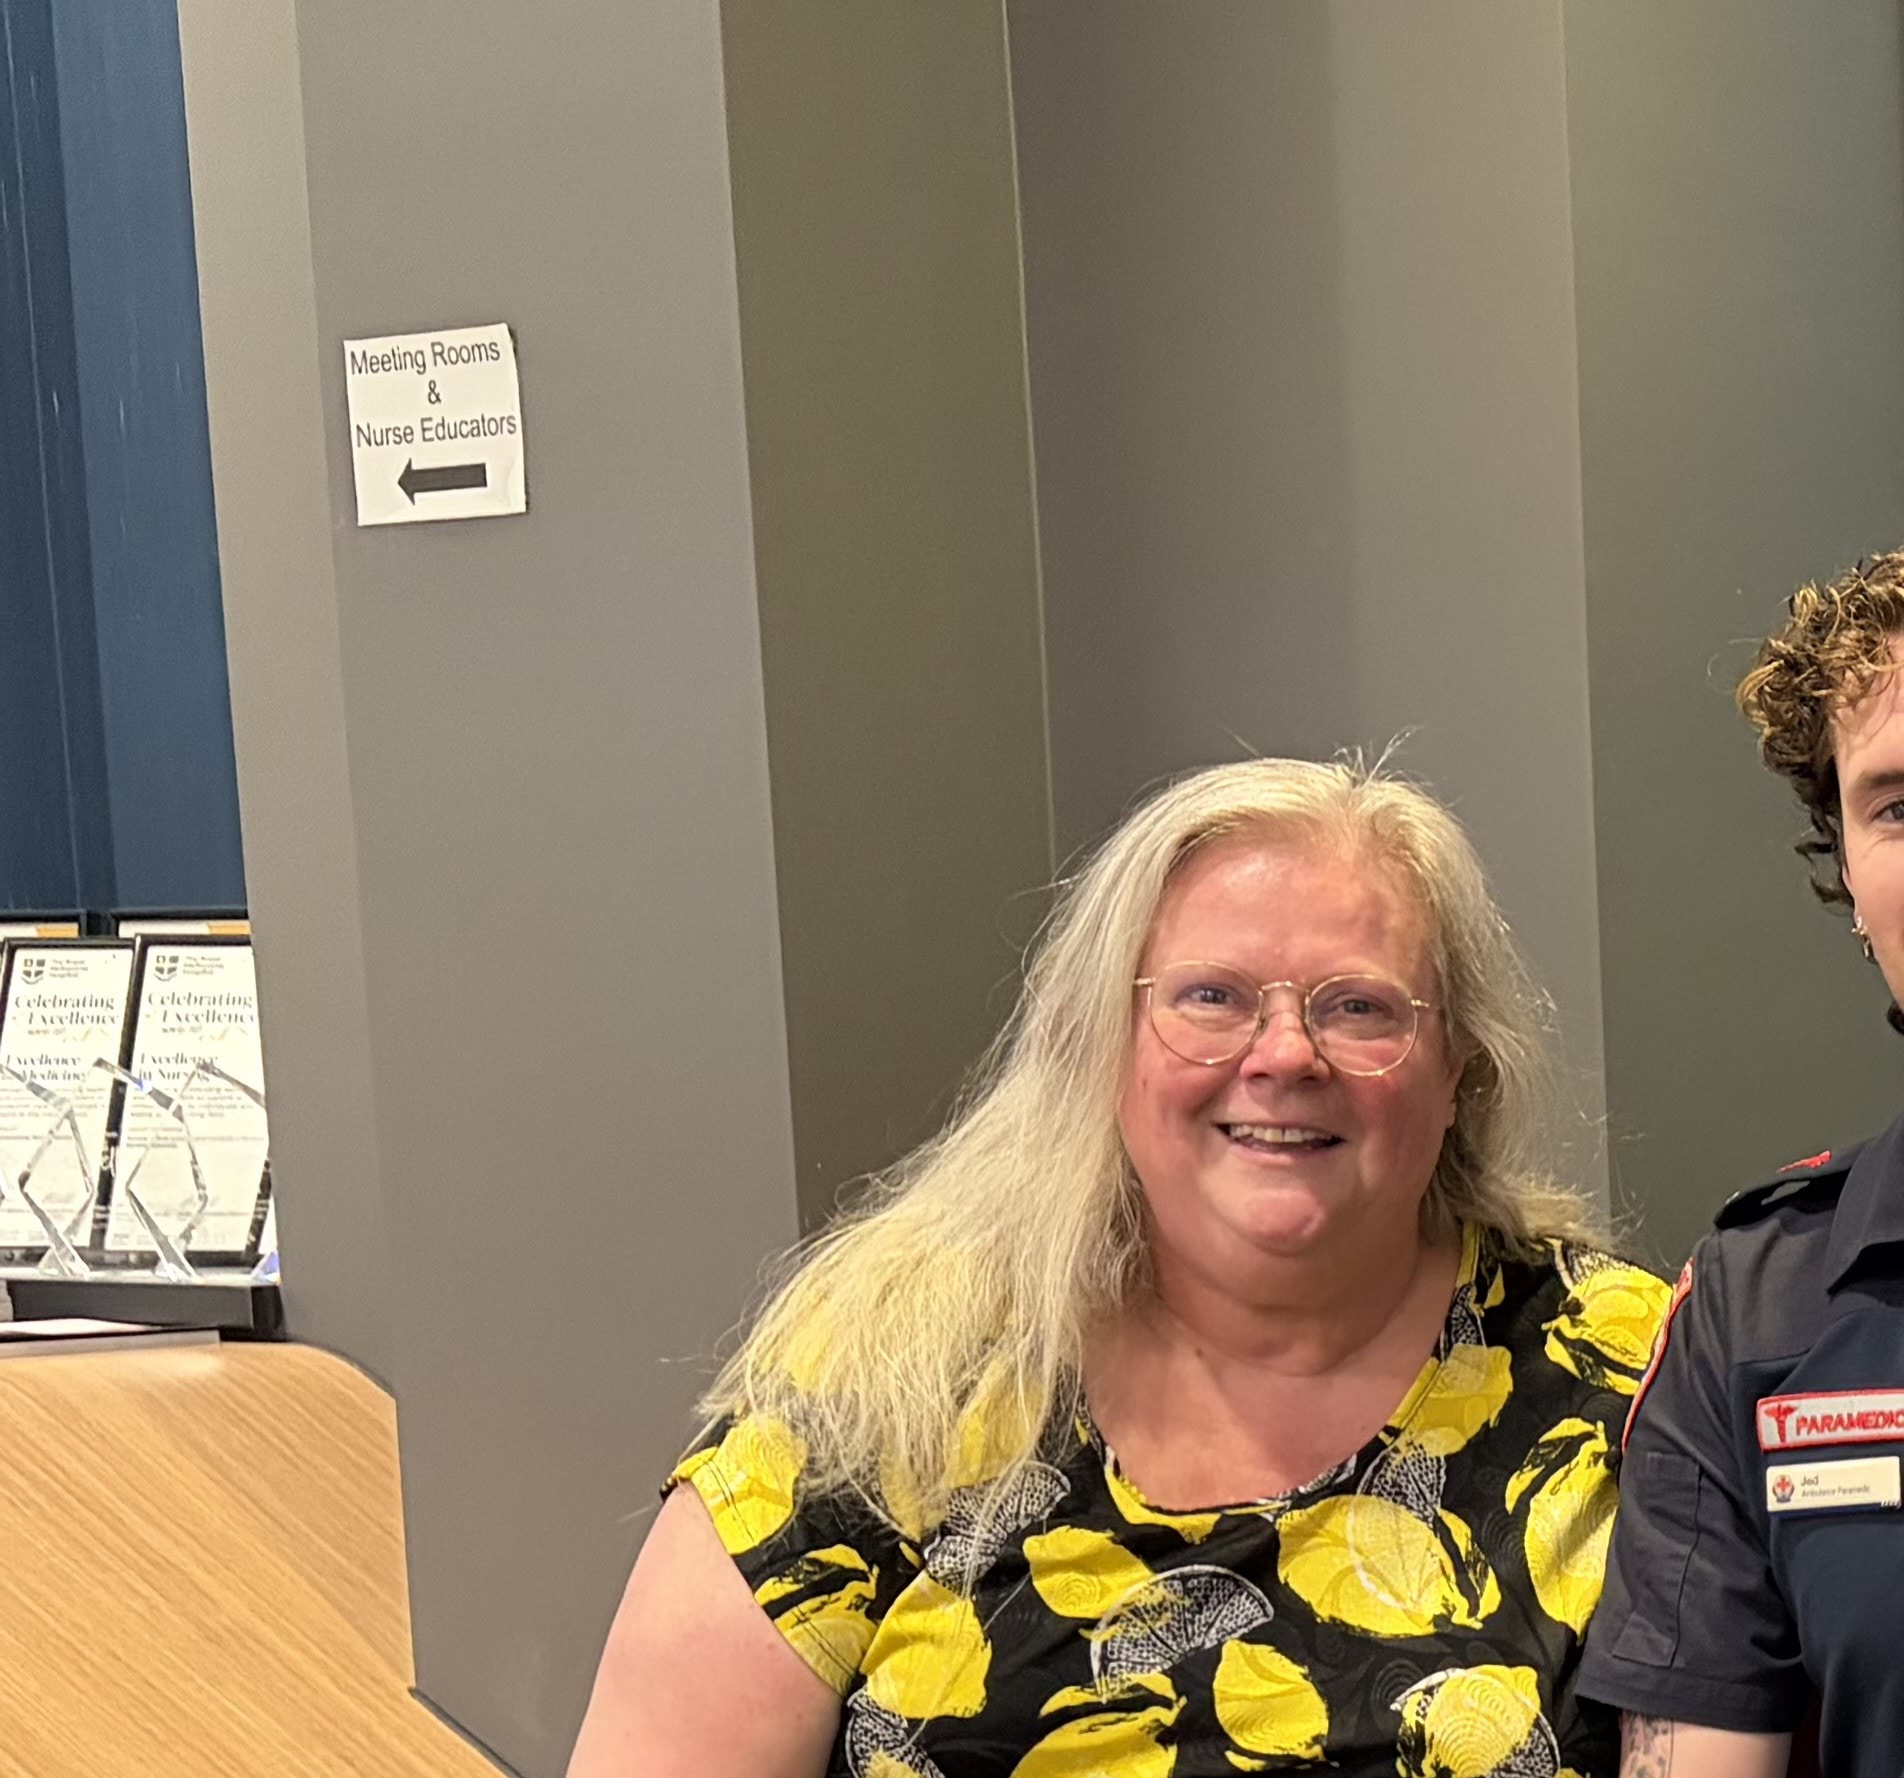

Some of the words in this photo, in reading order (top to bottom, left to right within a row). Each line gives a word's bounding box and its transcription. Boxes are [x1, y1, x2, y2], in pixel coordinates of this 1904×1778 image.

[350, 346, 427, 375] Meeting
[430, 341, 501, 367] Rooms
[427, 379, 442, 404] &
[356, 422, 415, 448] Nurse
[420, 412, 517, 443] Educators
[15, 994, 115, 1011] Celebrating
[148, 991, 253, 1009] Celebrating
[28, 1011, 119, 1025] Excellence
